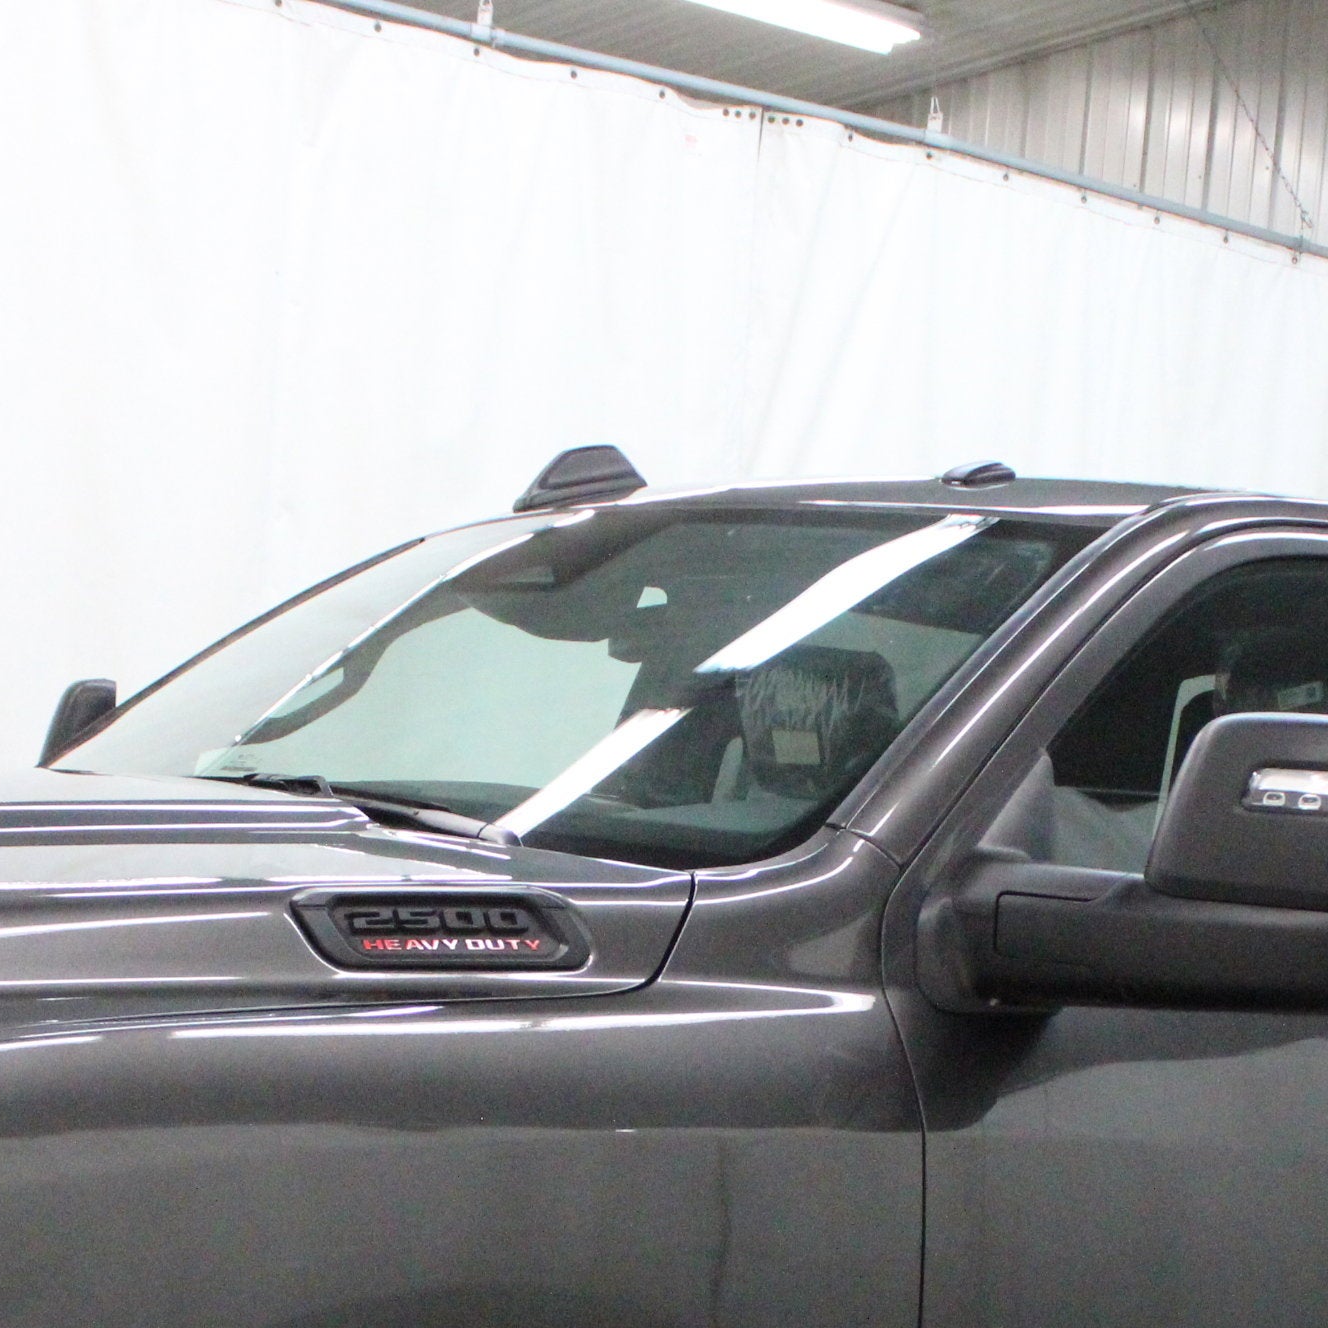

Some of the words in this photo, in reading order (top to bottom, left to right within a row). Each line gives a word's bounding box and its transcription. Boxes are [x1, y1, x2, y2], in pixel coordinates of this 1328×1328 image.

[344, 907, 529, 935] 2500
[362, 938, 458, 951] HEAVY
[464, 938, 541, 951] DUTY
